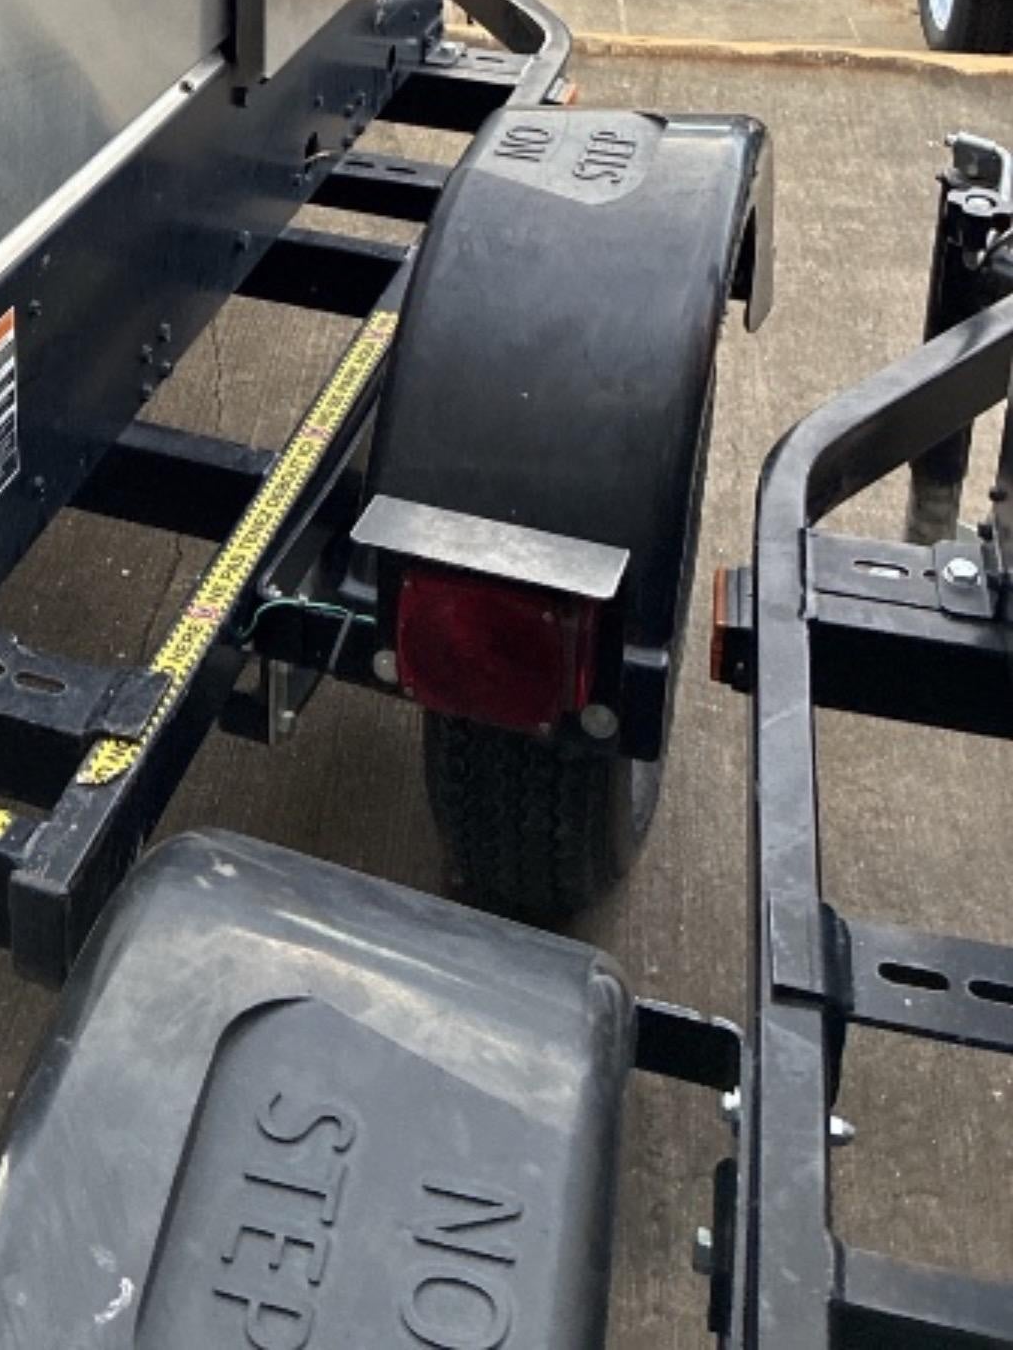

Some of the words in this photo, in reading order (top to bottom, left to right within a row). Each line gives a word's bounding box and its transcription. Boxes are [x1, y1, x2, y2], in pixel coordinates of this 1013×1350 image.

[494, 125, 552, 162] NO
[572, 130, 637, 185] STEP
[211, 1090, 357, 1350] STEP
[399, 1182, 524, 1350] NO
